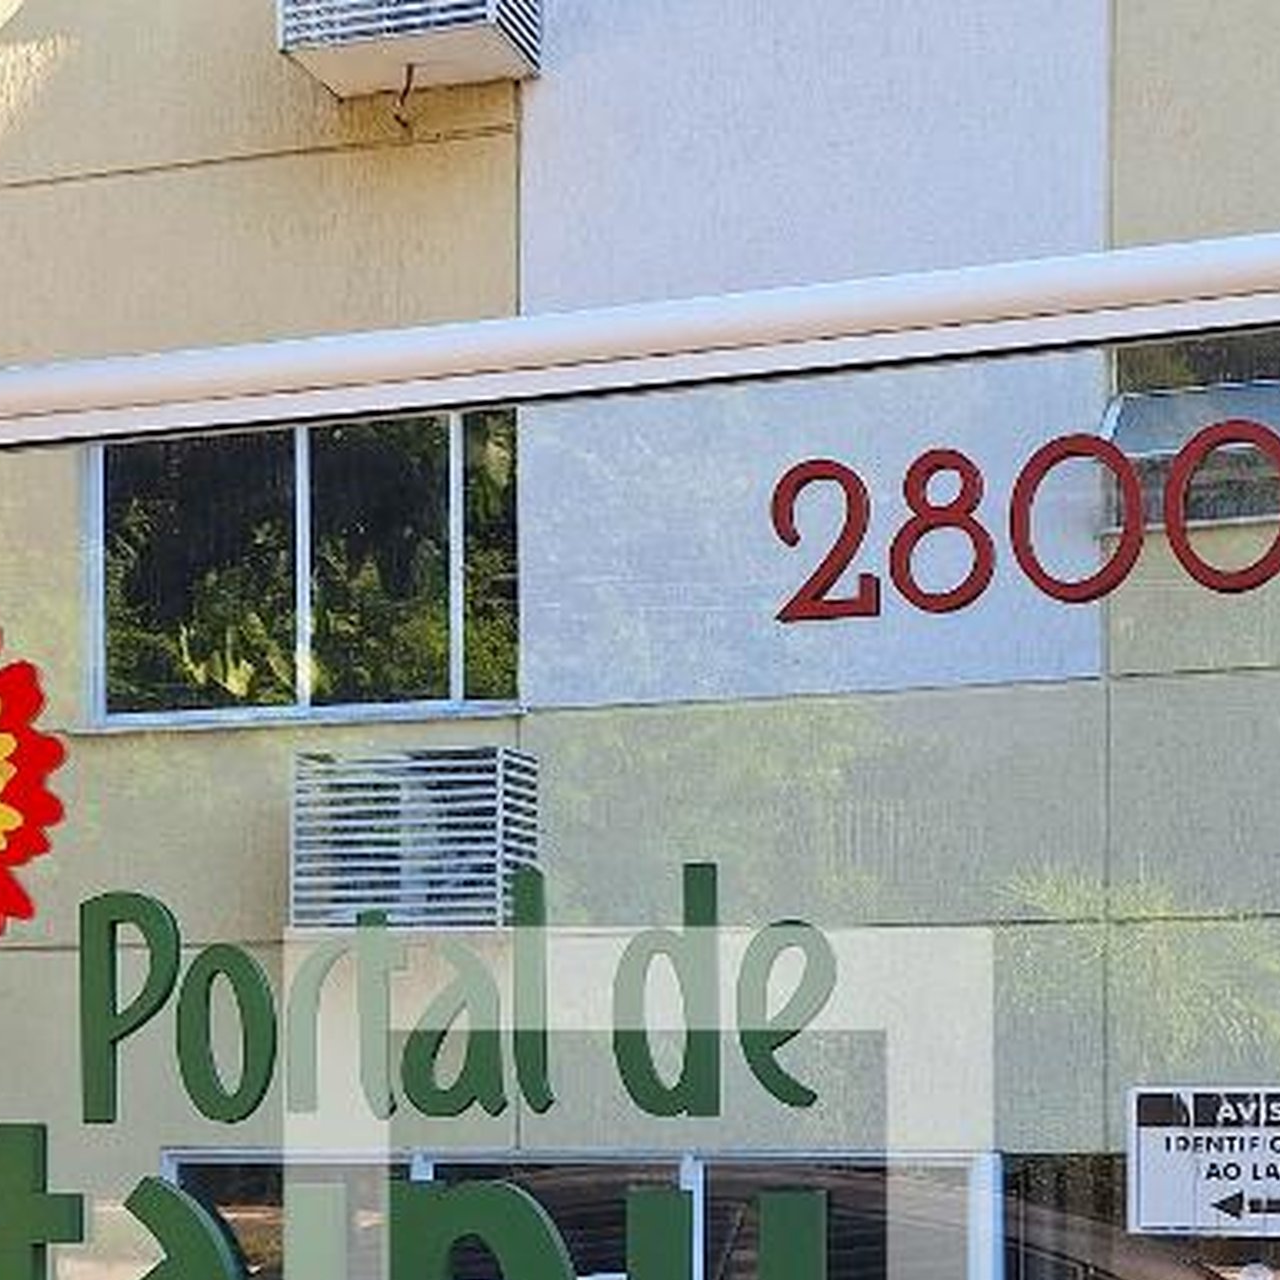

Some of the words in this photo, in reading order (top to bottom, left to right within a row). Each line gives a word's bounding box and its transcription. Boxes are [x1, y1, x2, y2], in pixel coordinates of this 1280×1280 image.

[79, 863, 555, 1124] Portal
[612, 863, 838, 1117] de
[1206, 1162, 1242, 1181] AO
